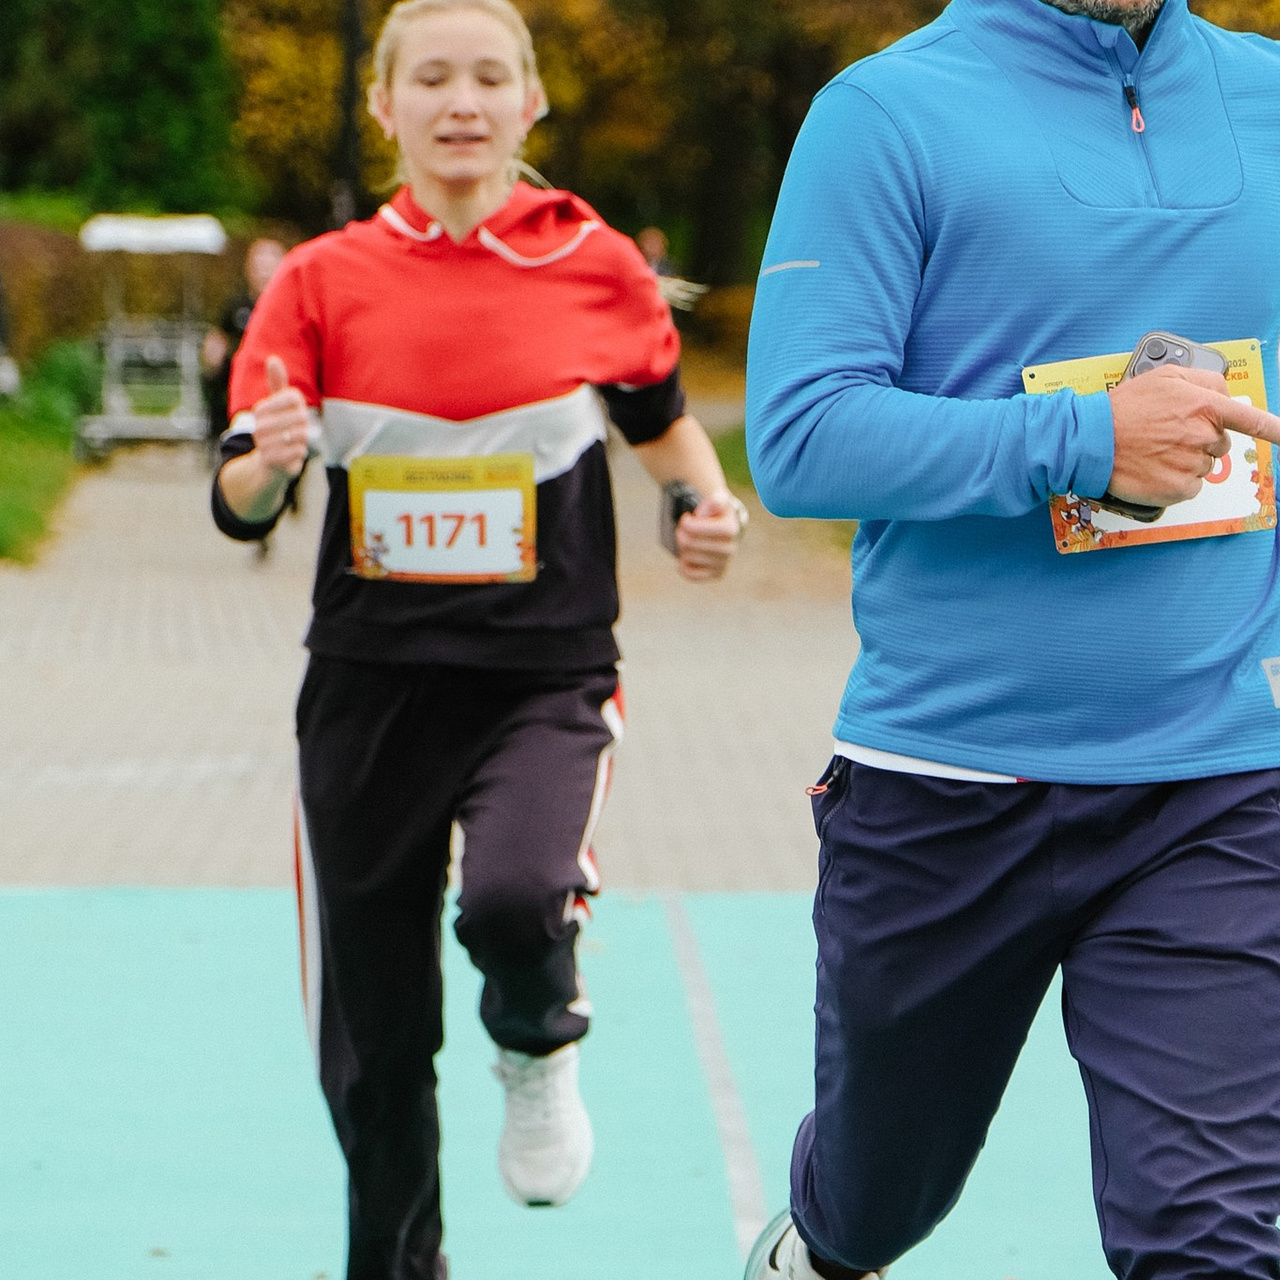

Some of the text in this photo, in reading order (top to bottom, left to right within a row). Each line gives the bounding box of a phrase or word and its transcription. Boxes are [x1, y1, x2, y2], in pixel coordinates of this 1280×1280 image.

[1228, 359, 1248, 369] 2025
[1224, 371, 1250, 382] сква
[397, 512, 487, 548] 1171
